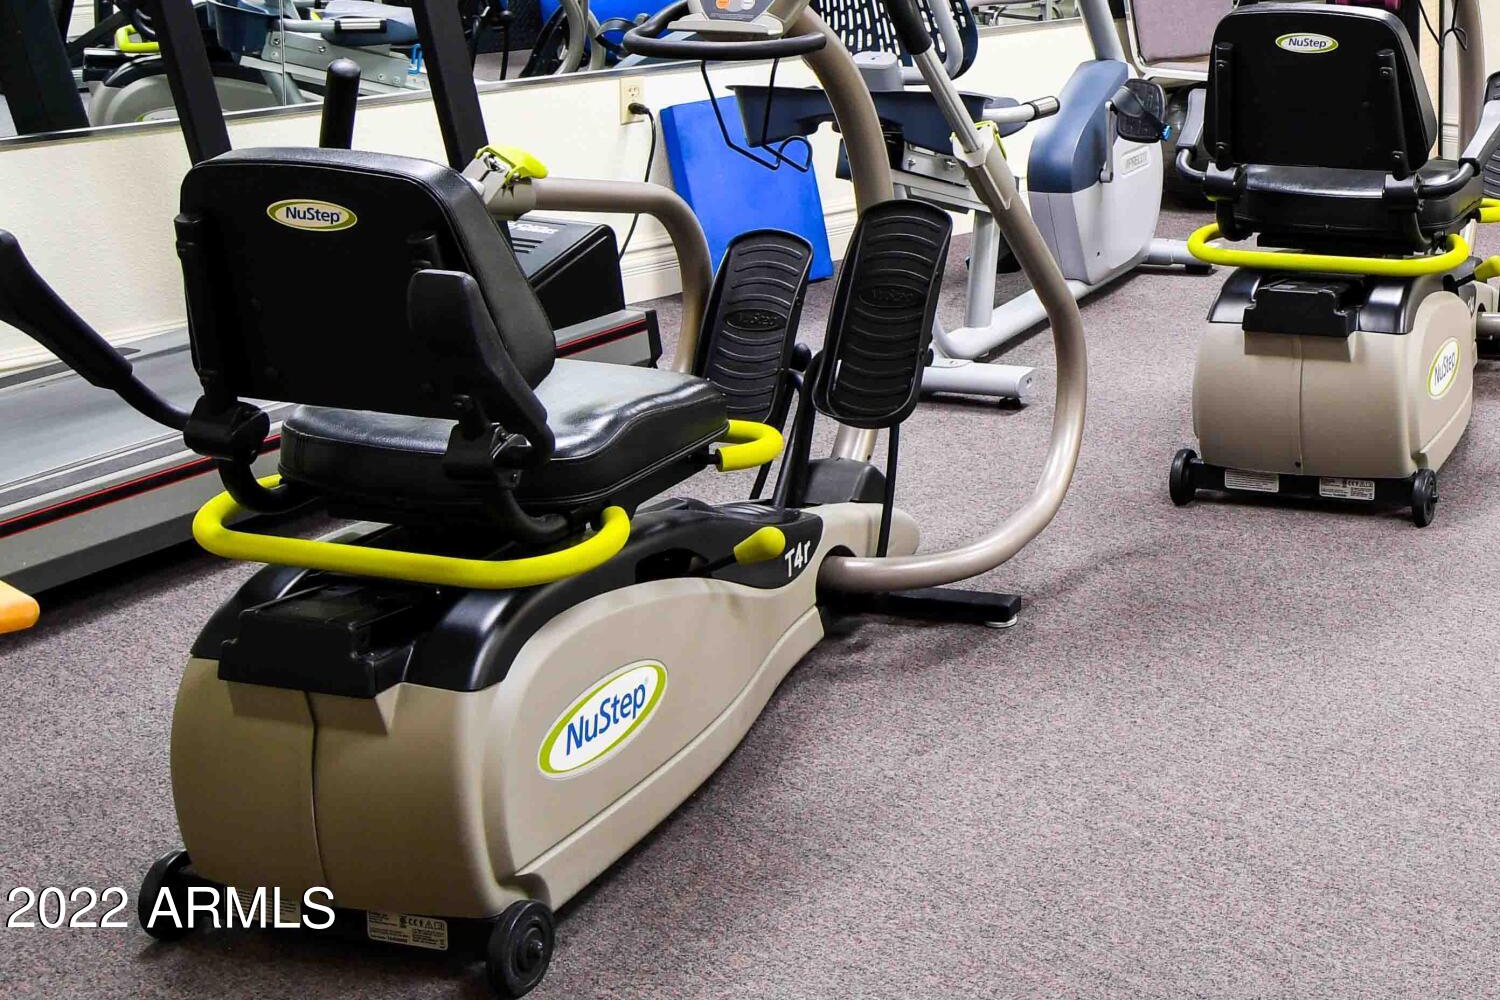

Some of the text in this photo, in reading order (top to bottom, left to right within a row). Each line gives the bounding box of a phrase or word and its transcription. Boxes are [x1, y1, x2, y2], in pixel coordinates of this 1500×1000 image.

[1289, 37, 1327, 48] NuStep
[285, 206, 341, 224] NuStep
[784, 540, 811, 578] T4r
[565, 683, 646, 756] NuStep
